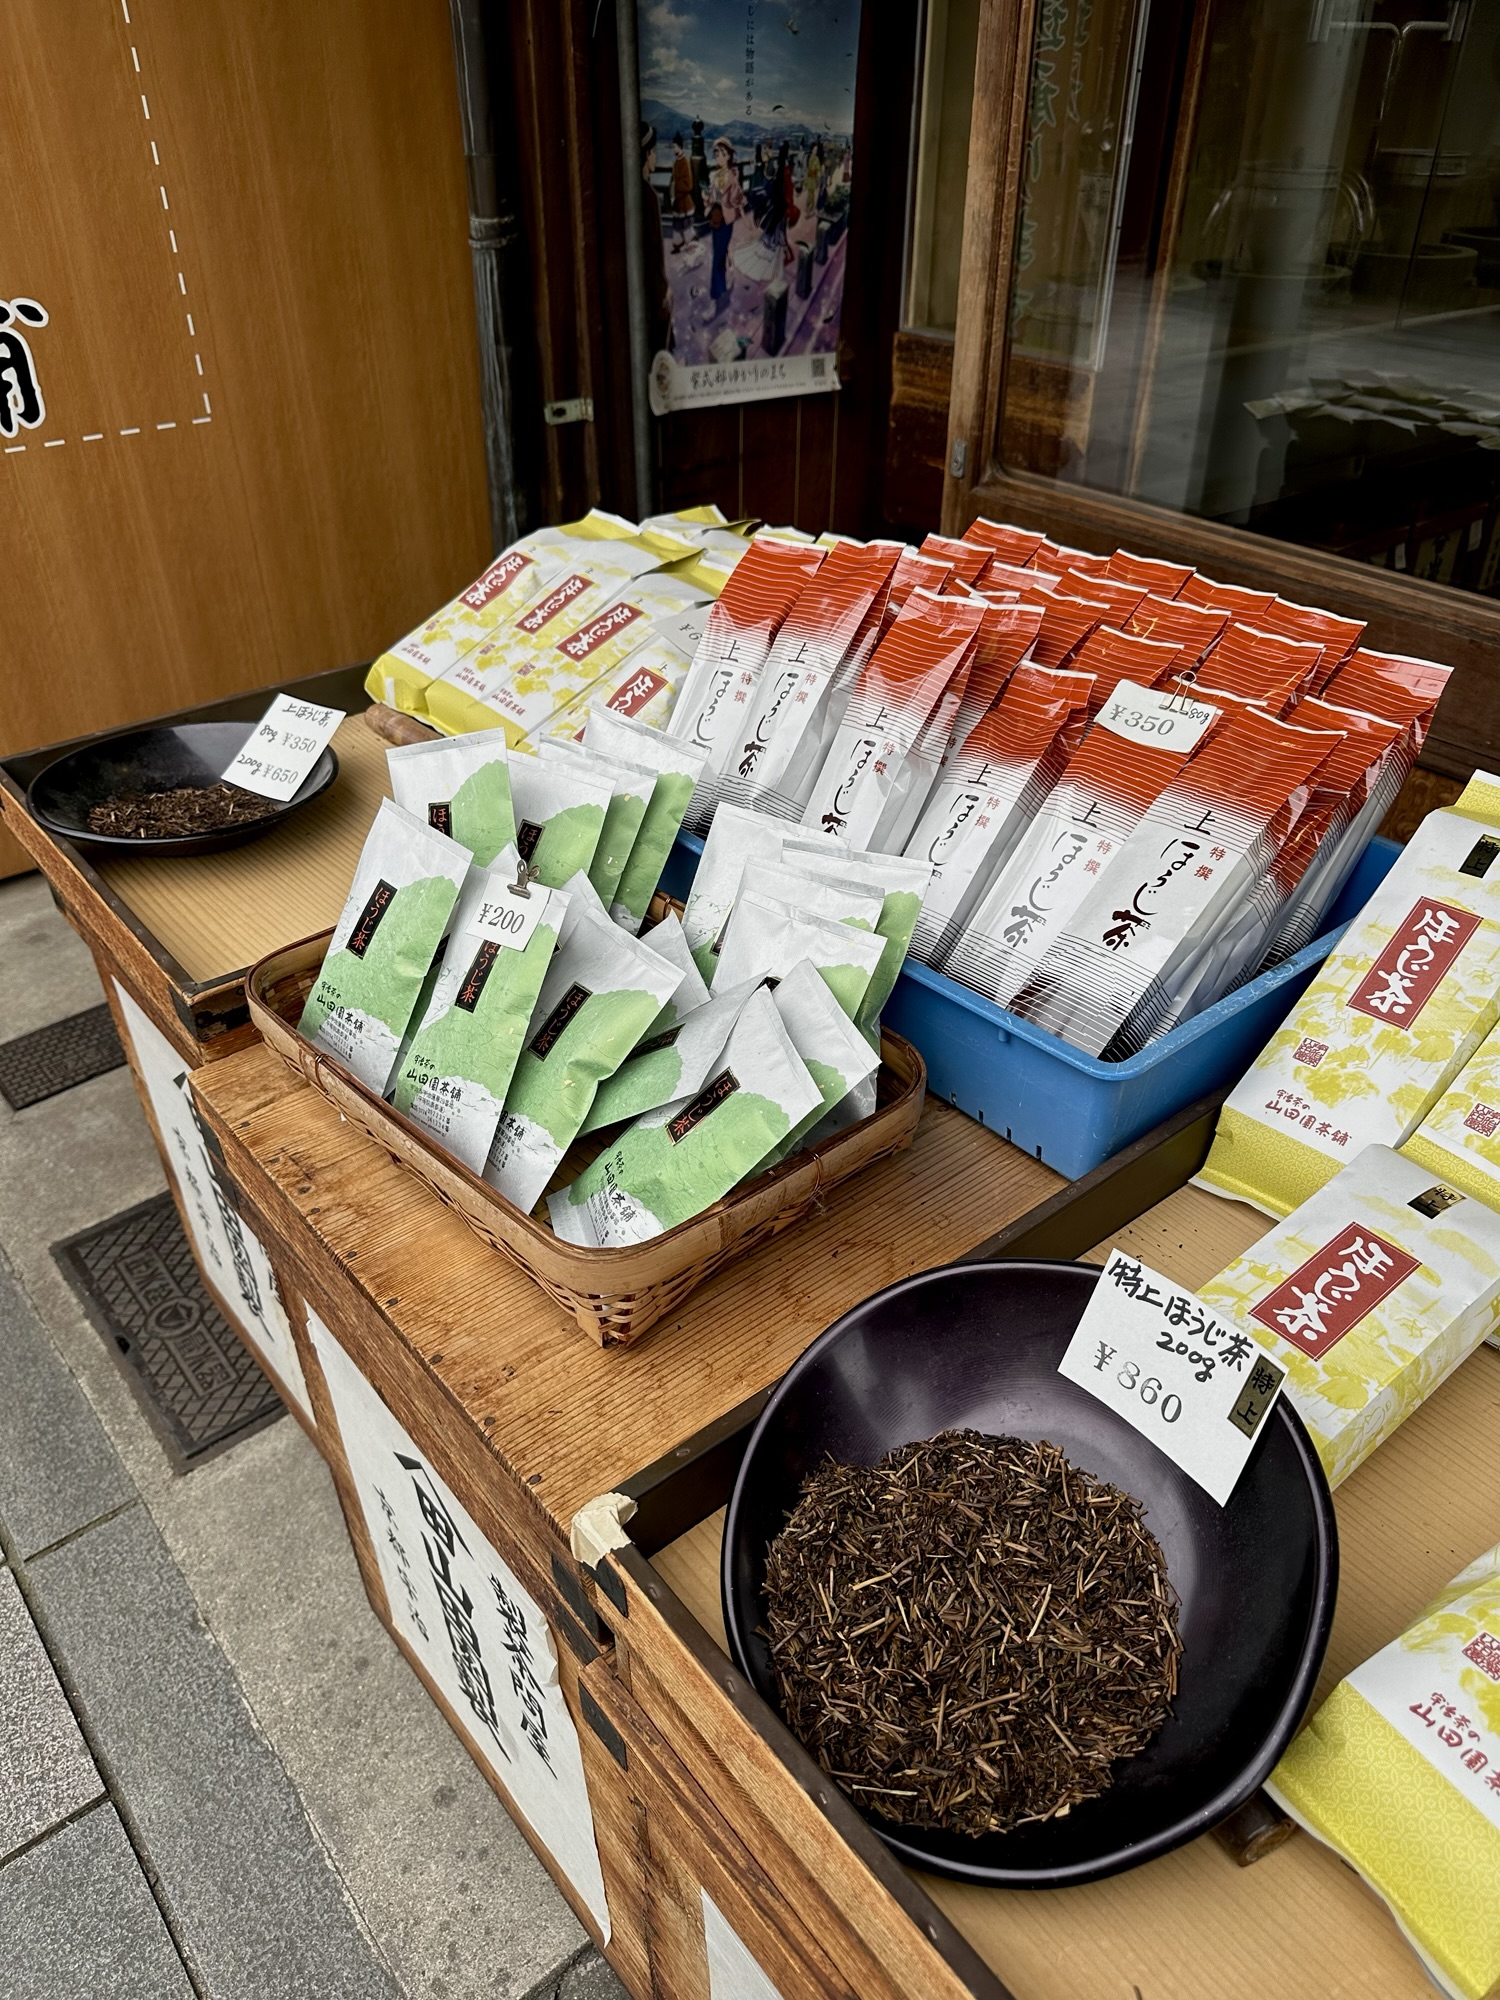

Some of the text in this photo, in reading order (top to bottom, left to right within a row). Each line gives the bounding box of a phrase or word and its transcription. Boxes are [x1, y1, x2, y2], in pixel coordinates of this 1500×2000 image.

[465, 555, 524, 606] ほうじ茶
[523, 578, 585, 630] ほうじ茶
[566, 606, 633, 655] ほうじ茶
[260, 724, 317, 753] 80g ¥350
[281, 703, 334, 728] 上ほうじ茶
[1109, 703, 1210, 736] ¥350 80g
[236, 754, 299, 784] 200g ¥650
[1193, 846, 1227, 881] 特撰
[351, 886, 391, 951] ほうじ茶
[477, 903, 525, 934] ¥200
[1365, 908, 1462, 1017] ほうじ茶
[535, 989, 584, 1052] ほうじ茶
[671, 1075, 732, 1140] ほうじ茶
[1265, 1100, 1353, 1147] 山田園茶舗
[1276, 1089, 1311, 1111] 宇治茶の
[1107, 1257, 1255, 1373] 特上ほうじ茶
[1272, 1236, 1395, 1341] ほうじ茶
[1093, 1340, 1184, 1424] ¥860
[1155, 1330, 1217, 1384] 200g
[1235, 1367, 1276, 1427] 特上
[372, 1484, 429, 1642] 京都宇治
[420, 1530, 511, 1763] 山田園製
[488, 1573, 558, 1780] 製茶問屋
[1430, 1692, 1481, 1742] 宇治茶の
